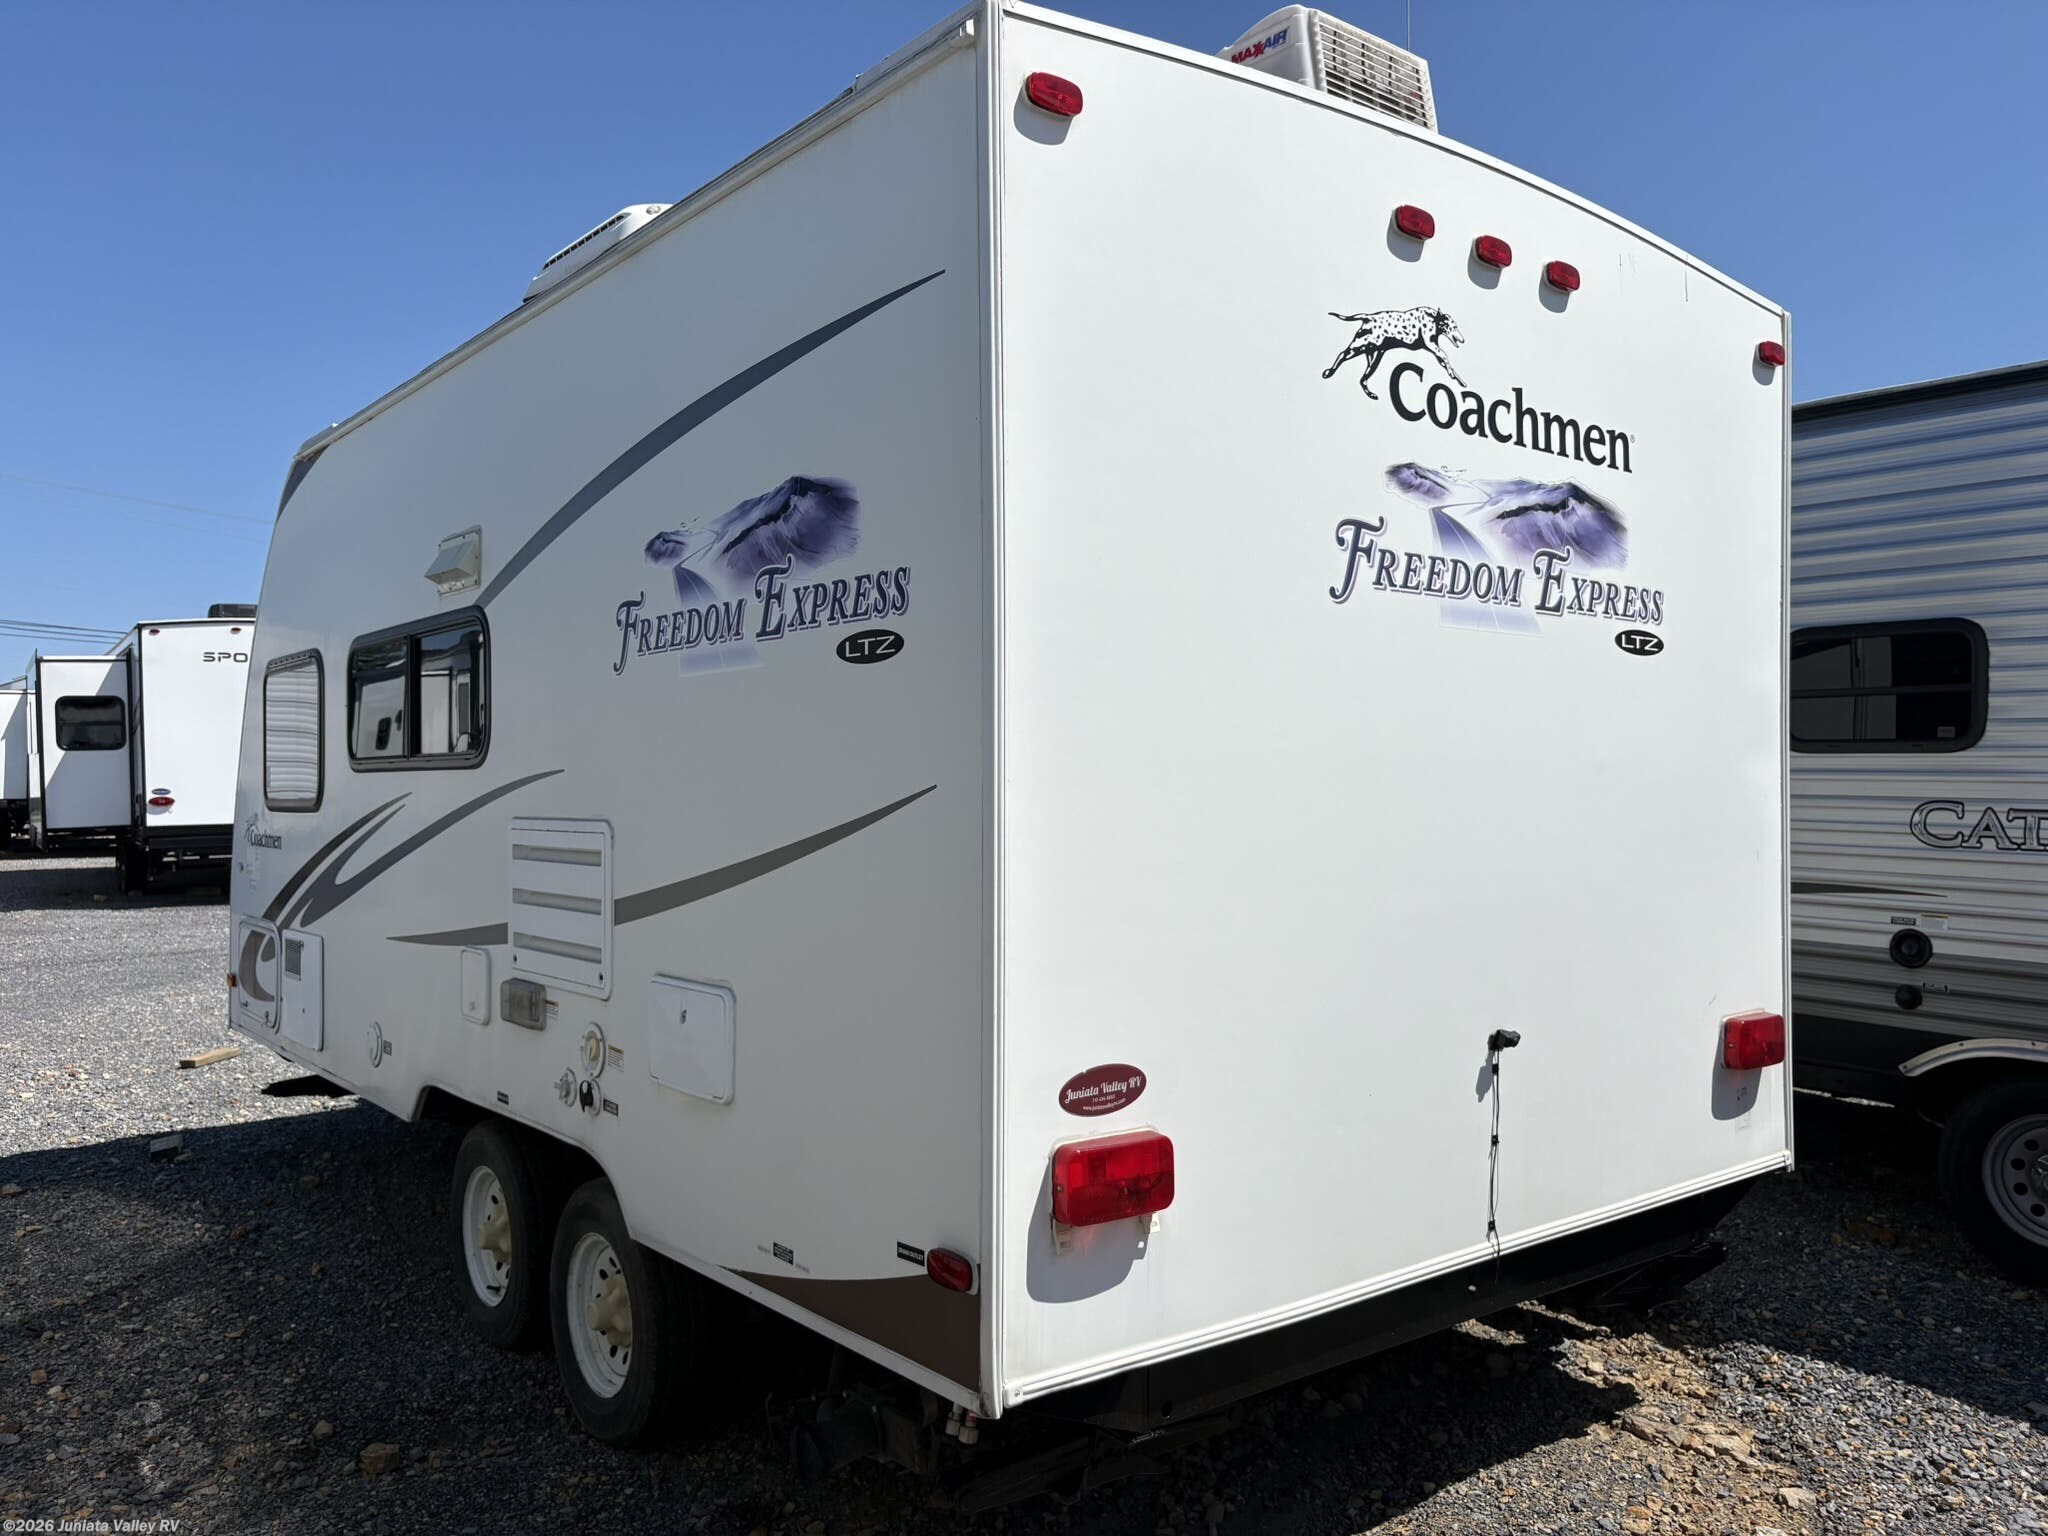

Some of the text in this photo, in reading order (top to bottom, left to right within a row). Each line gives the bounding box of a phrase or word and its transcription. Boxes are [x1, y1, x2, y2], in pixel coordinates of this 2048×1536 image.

[1389, 361, 1633, 474] Coachmen
[1328, 515, 1665, 626] FREEDOM EXPRESS
[614, 553, 911, 676] FREEDOM EXPRESS
[843, 634, 897, 660] LTZ
[1620, 634, 1660, 653] LTZ
[250, 829, 282, 849] Coachmen
[1065, 1086, 1099, 1104] Juniata
[1101, 1081, 1127, 1093] Valley
[1129, 1076, 1142, 1088] RV
